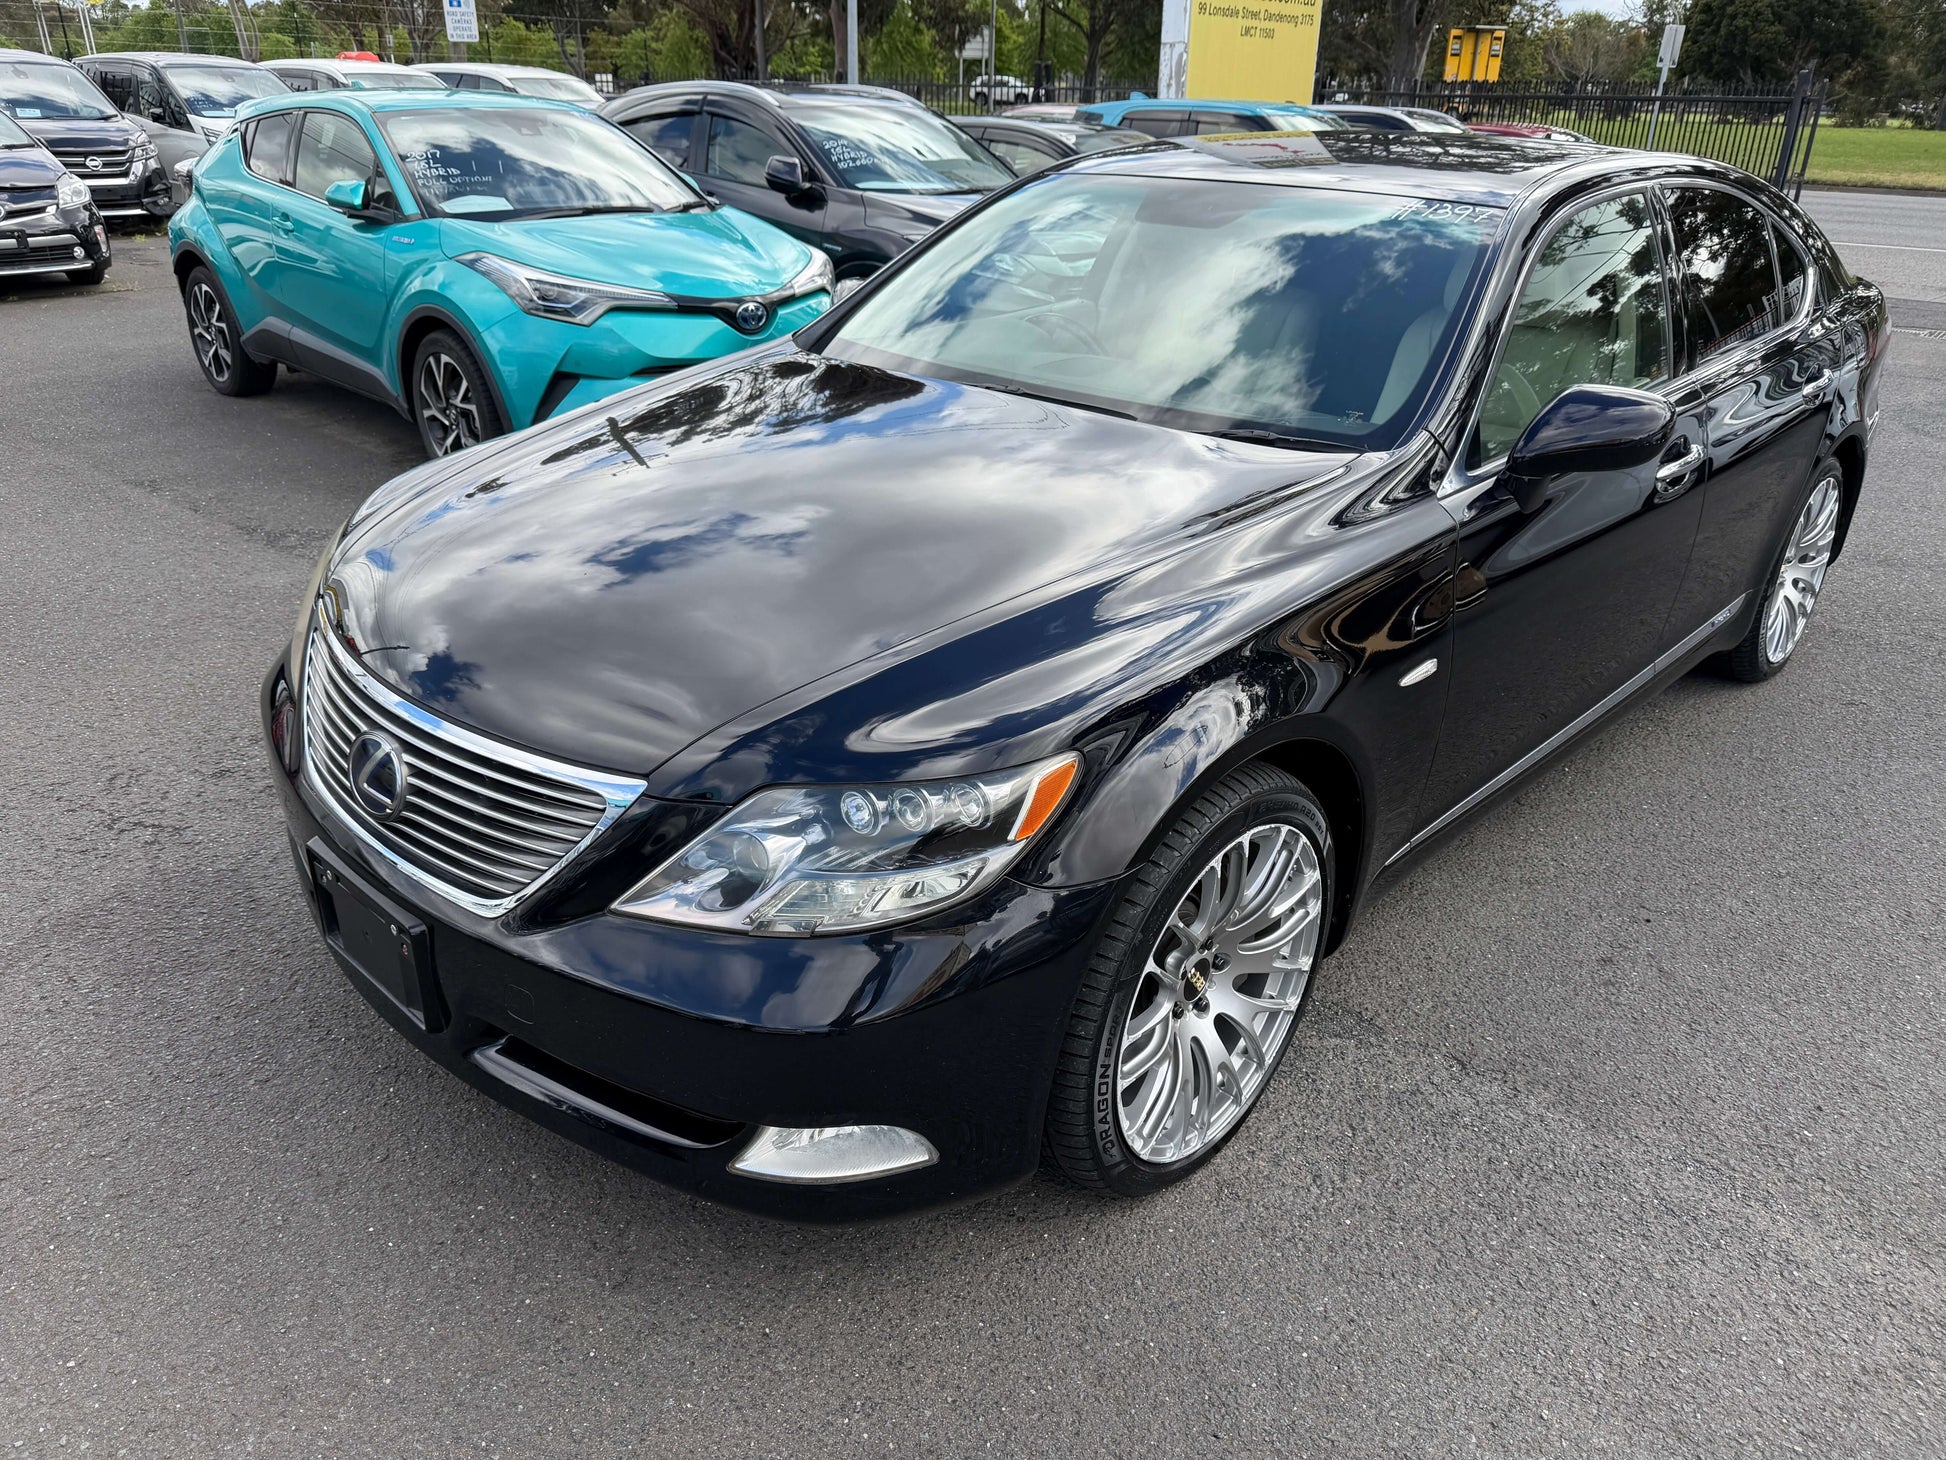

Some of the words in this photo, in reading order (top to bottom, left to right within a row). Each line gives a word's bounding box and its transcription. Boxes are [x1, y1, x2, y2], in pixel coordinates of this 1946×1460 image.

[1198, 2, 1208, 15] 99
[1208, 3, 1240, 18] Lonsdale
[1241, 6, 1262, 23] Street,
[1263, 9, 1299, 28] Dandenong
[1300, 14, 1314, 26] 3175
[1240, 25, 1257, 38] LMCT
[1258, 27, 1275, 39] 11503
[405, 149, 441, 162] 2017
[830, 150, 867, 162] HYBRID
[413, 167, 461, 179] HYBRID
[416, 177, 447, 187] FULL
[1391, 199, 1493, 224] #1397
[1097, 1063, 1117, 1158] DRAGON
